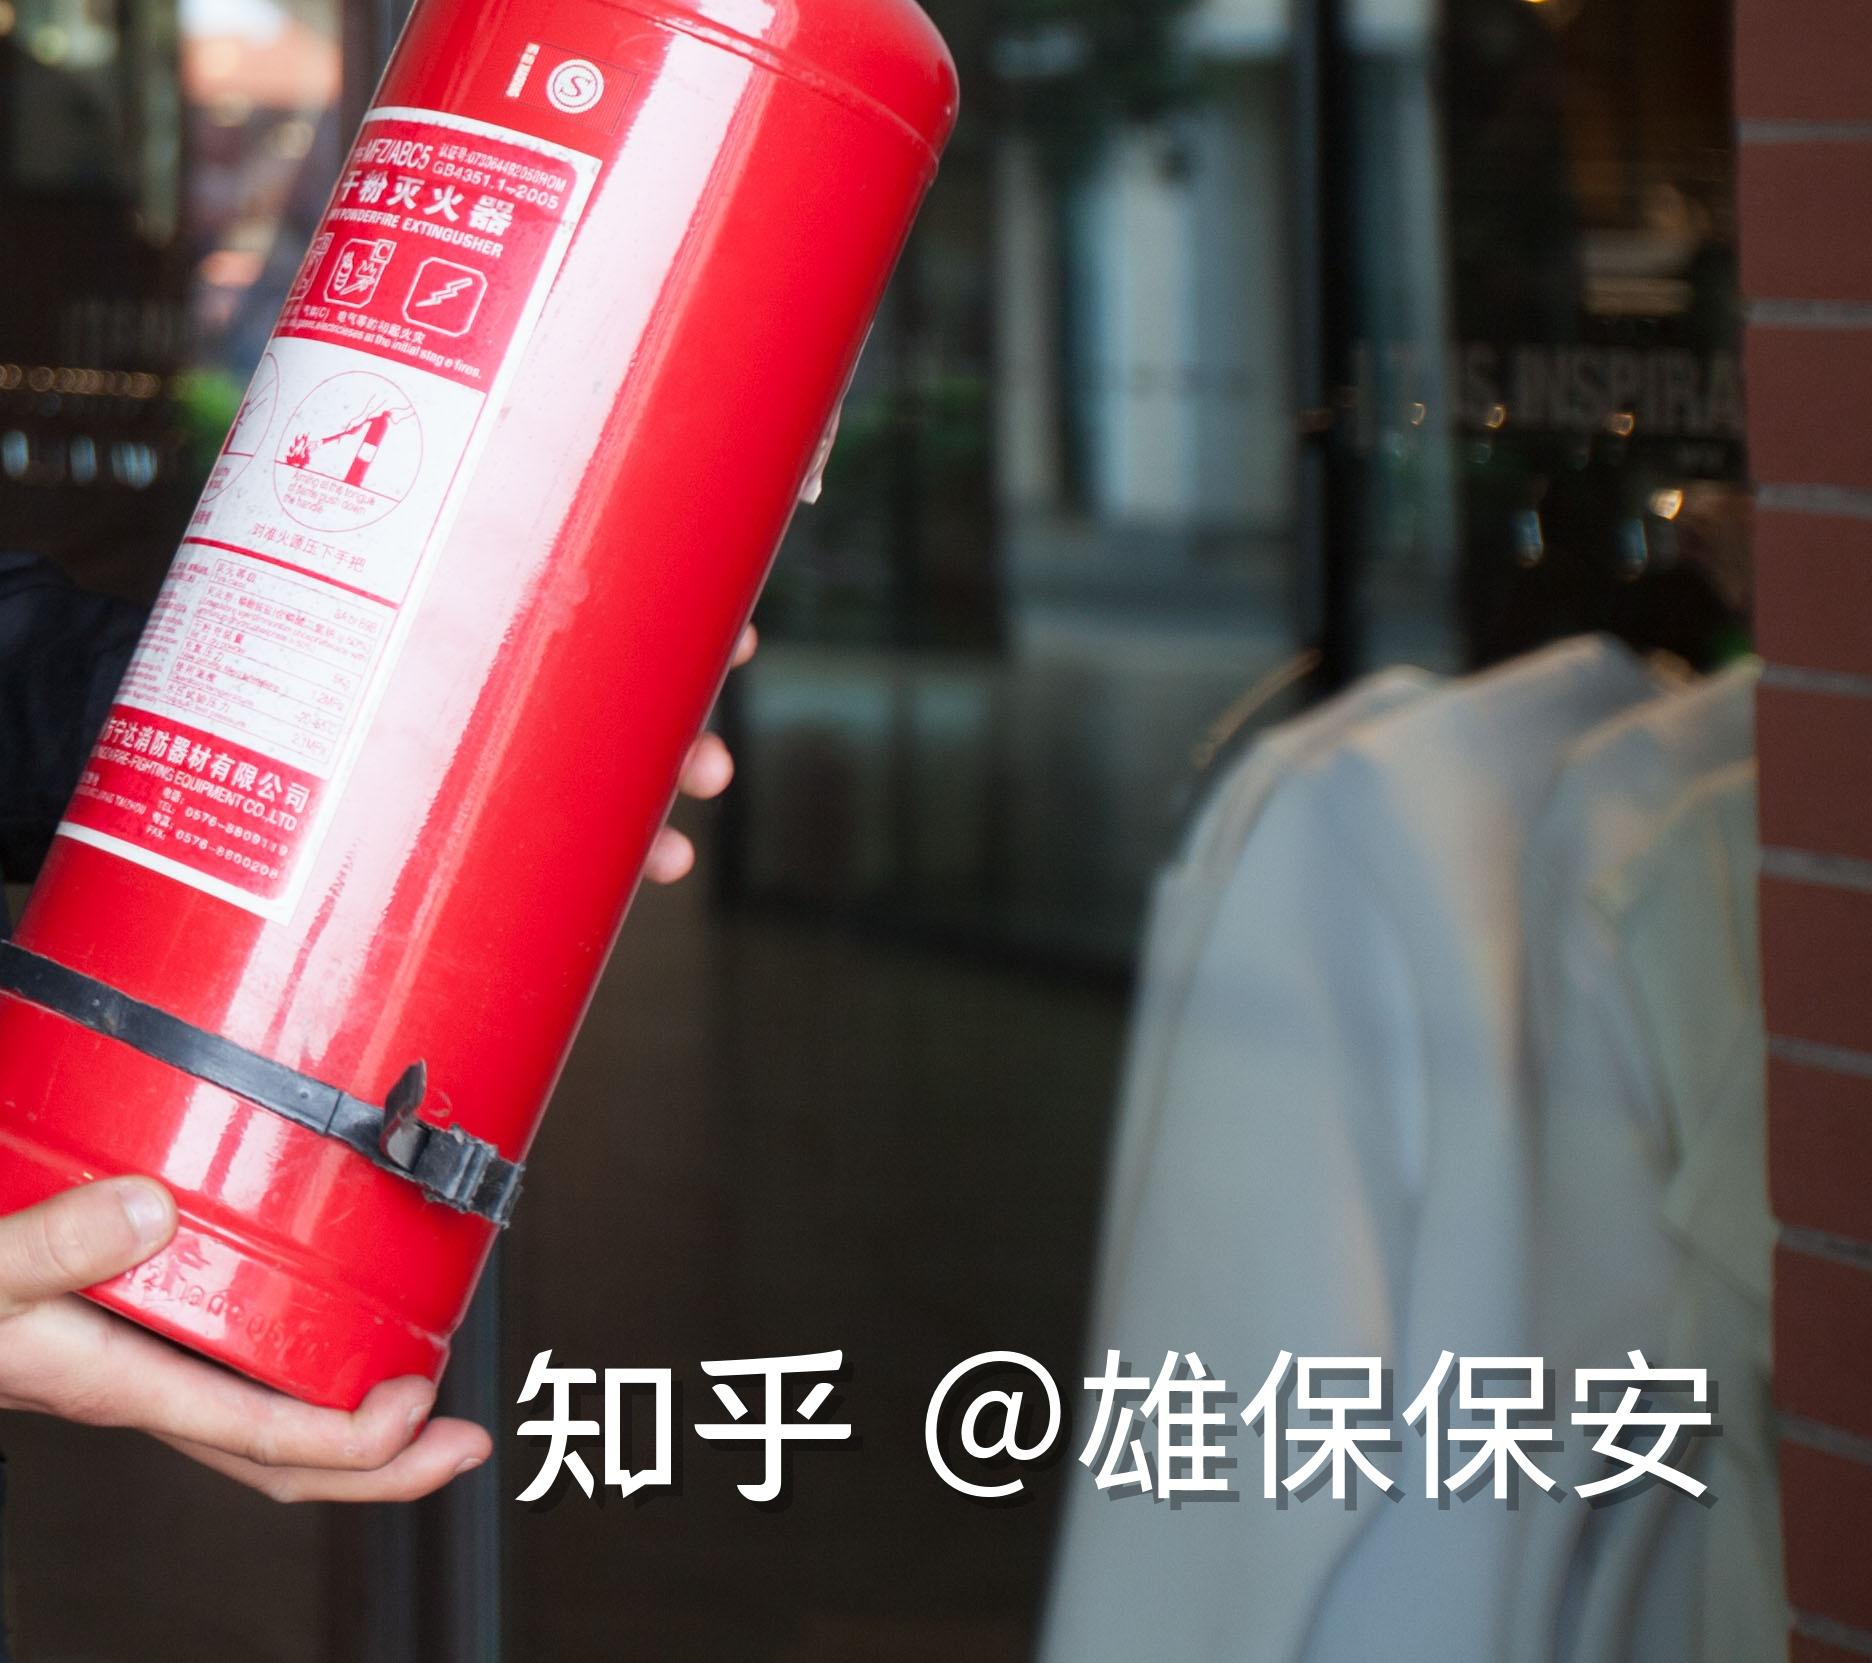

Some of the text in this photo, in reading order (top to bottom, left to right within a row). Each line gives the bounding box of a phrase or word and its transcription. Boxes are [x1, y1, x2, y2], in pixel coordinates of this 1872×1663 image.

[342, 169, 514, 236] 干粉灭火器
[402, 217, 504, 257] EXTINGUSHER
